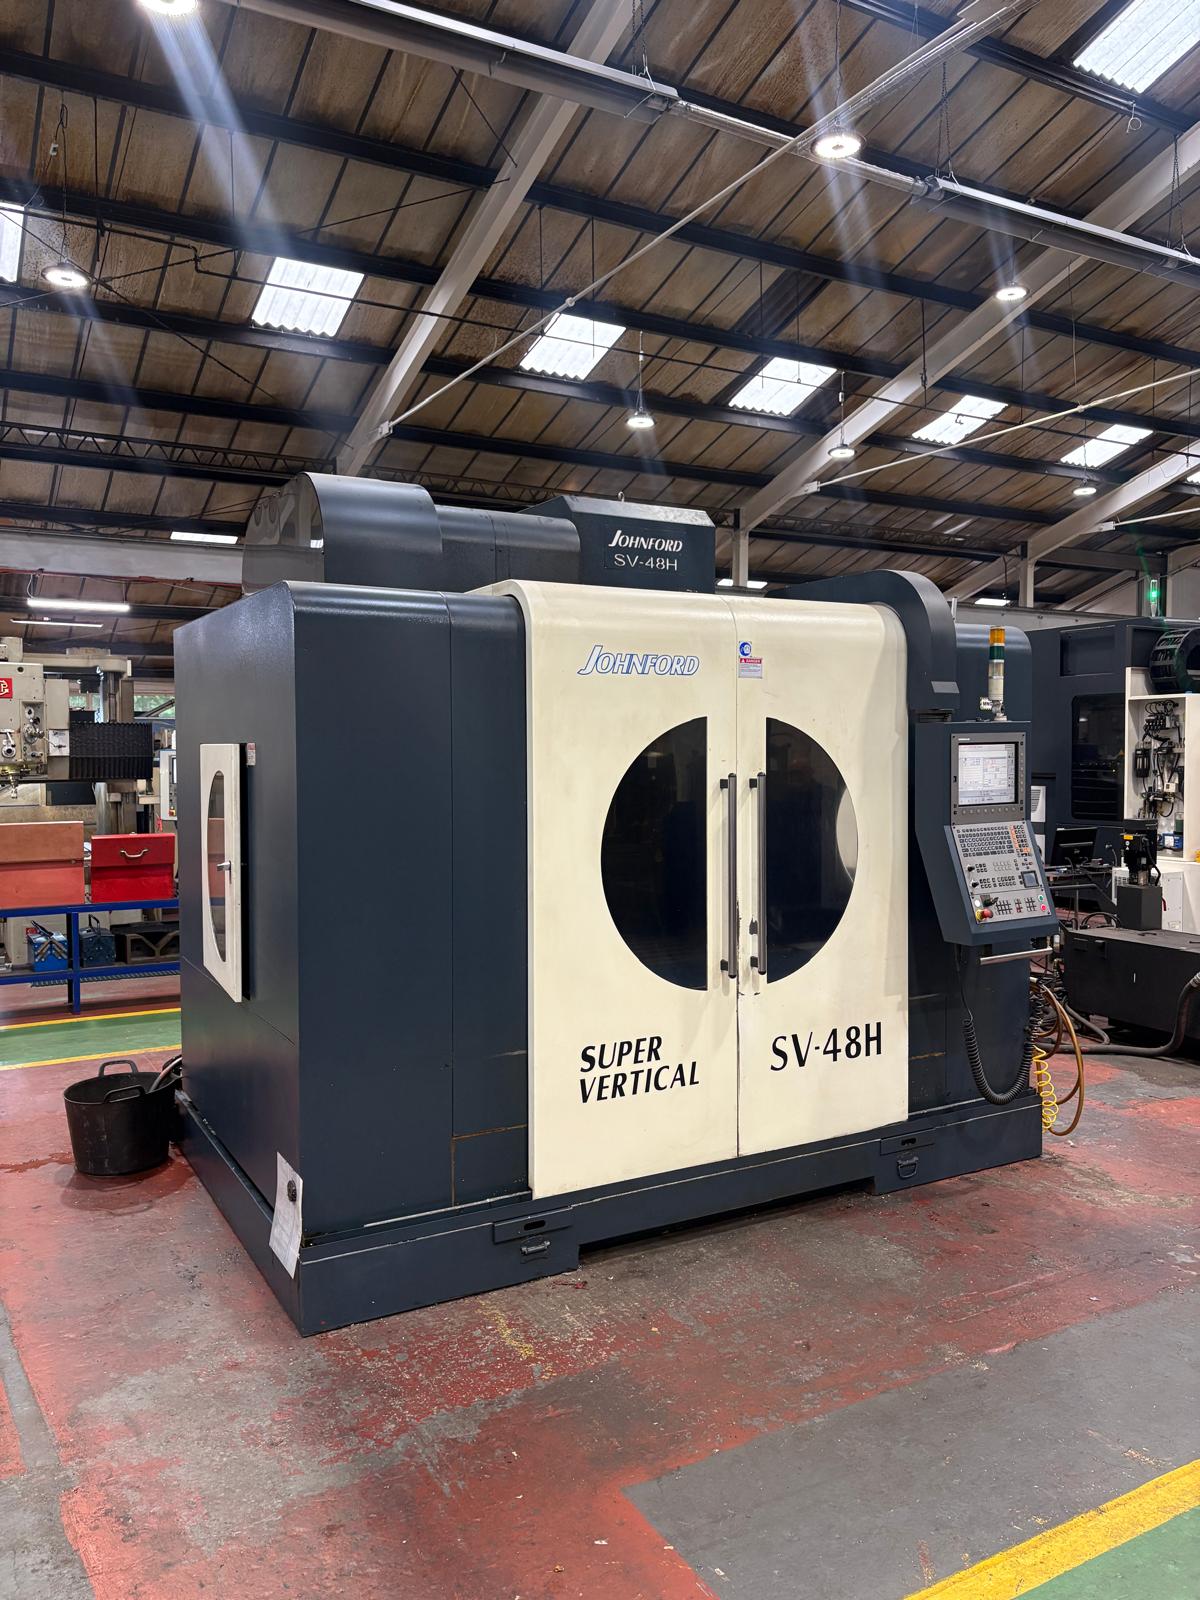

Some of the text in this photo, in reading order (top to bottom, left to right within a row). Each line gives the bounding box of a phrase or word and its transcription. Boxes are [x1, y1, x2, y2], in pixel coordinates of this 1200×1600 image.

[608, 529, 683, 552] JOHNFORD
[614, 553, 678, 571] SV-48H
[577, 644, 700, 676] JOHNFORD
[580, 1035, 662, 1073] SUPER
[770, 1021, 882, 1071] SV-48H
[579, 1061, 700, 1104] VERTICAL
